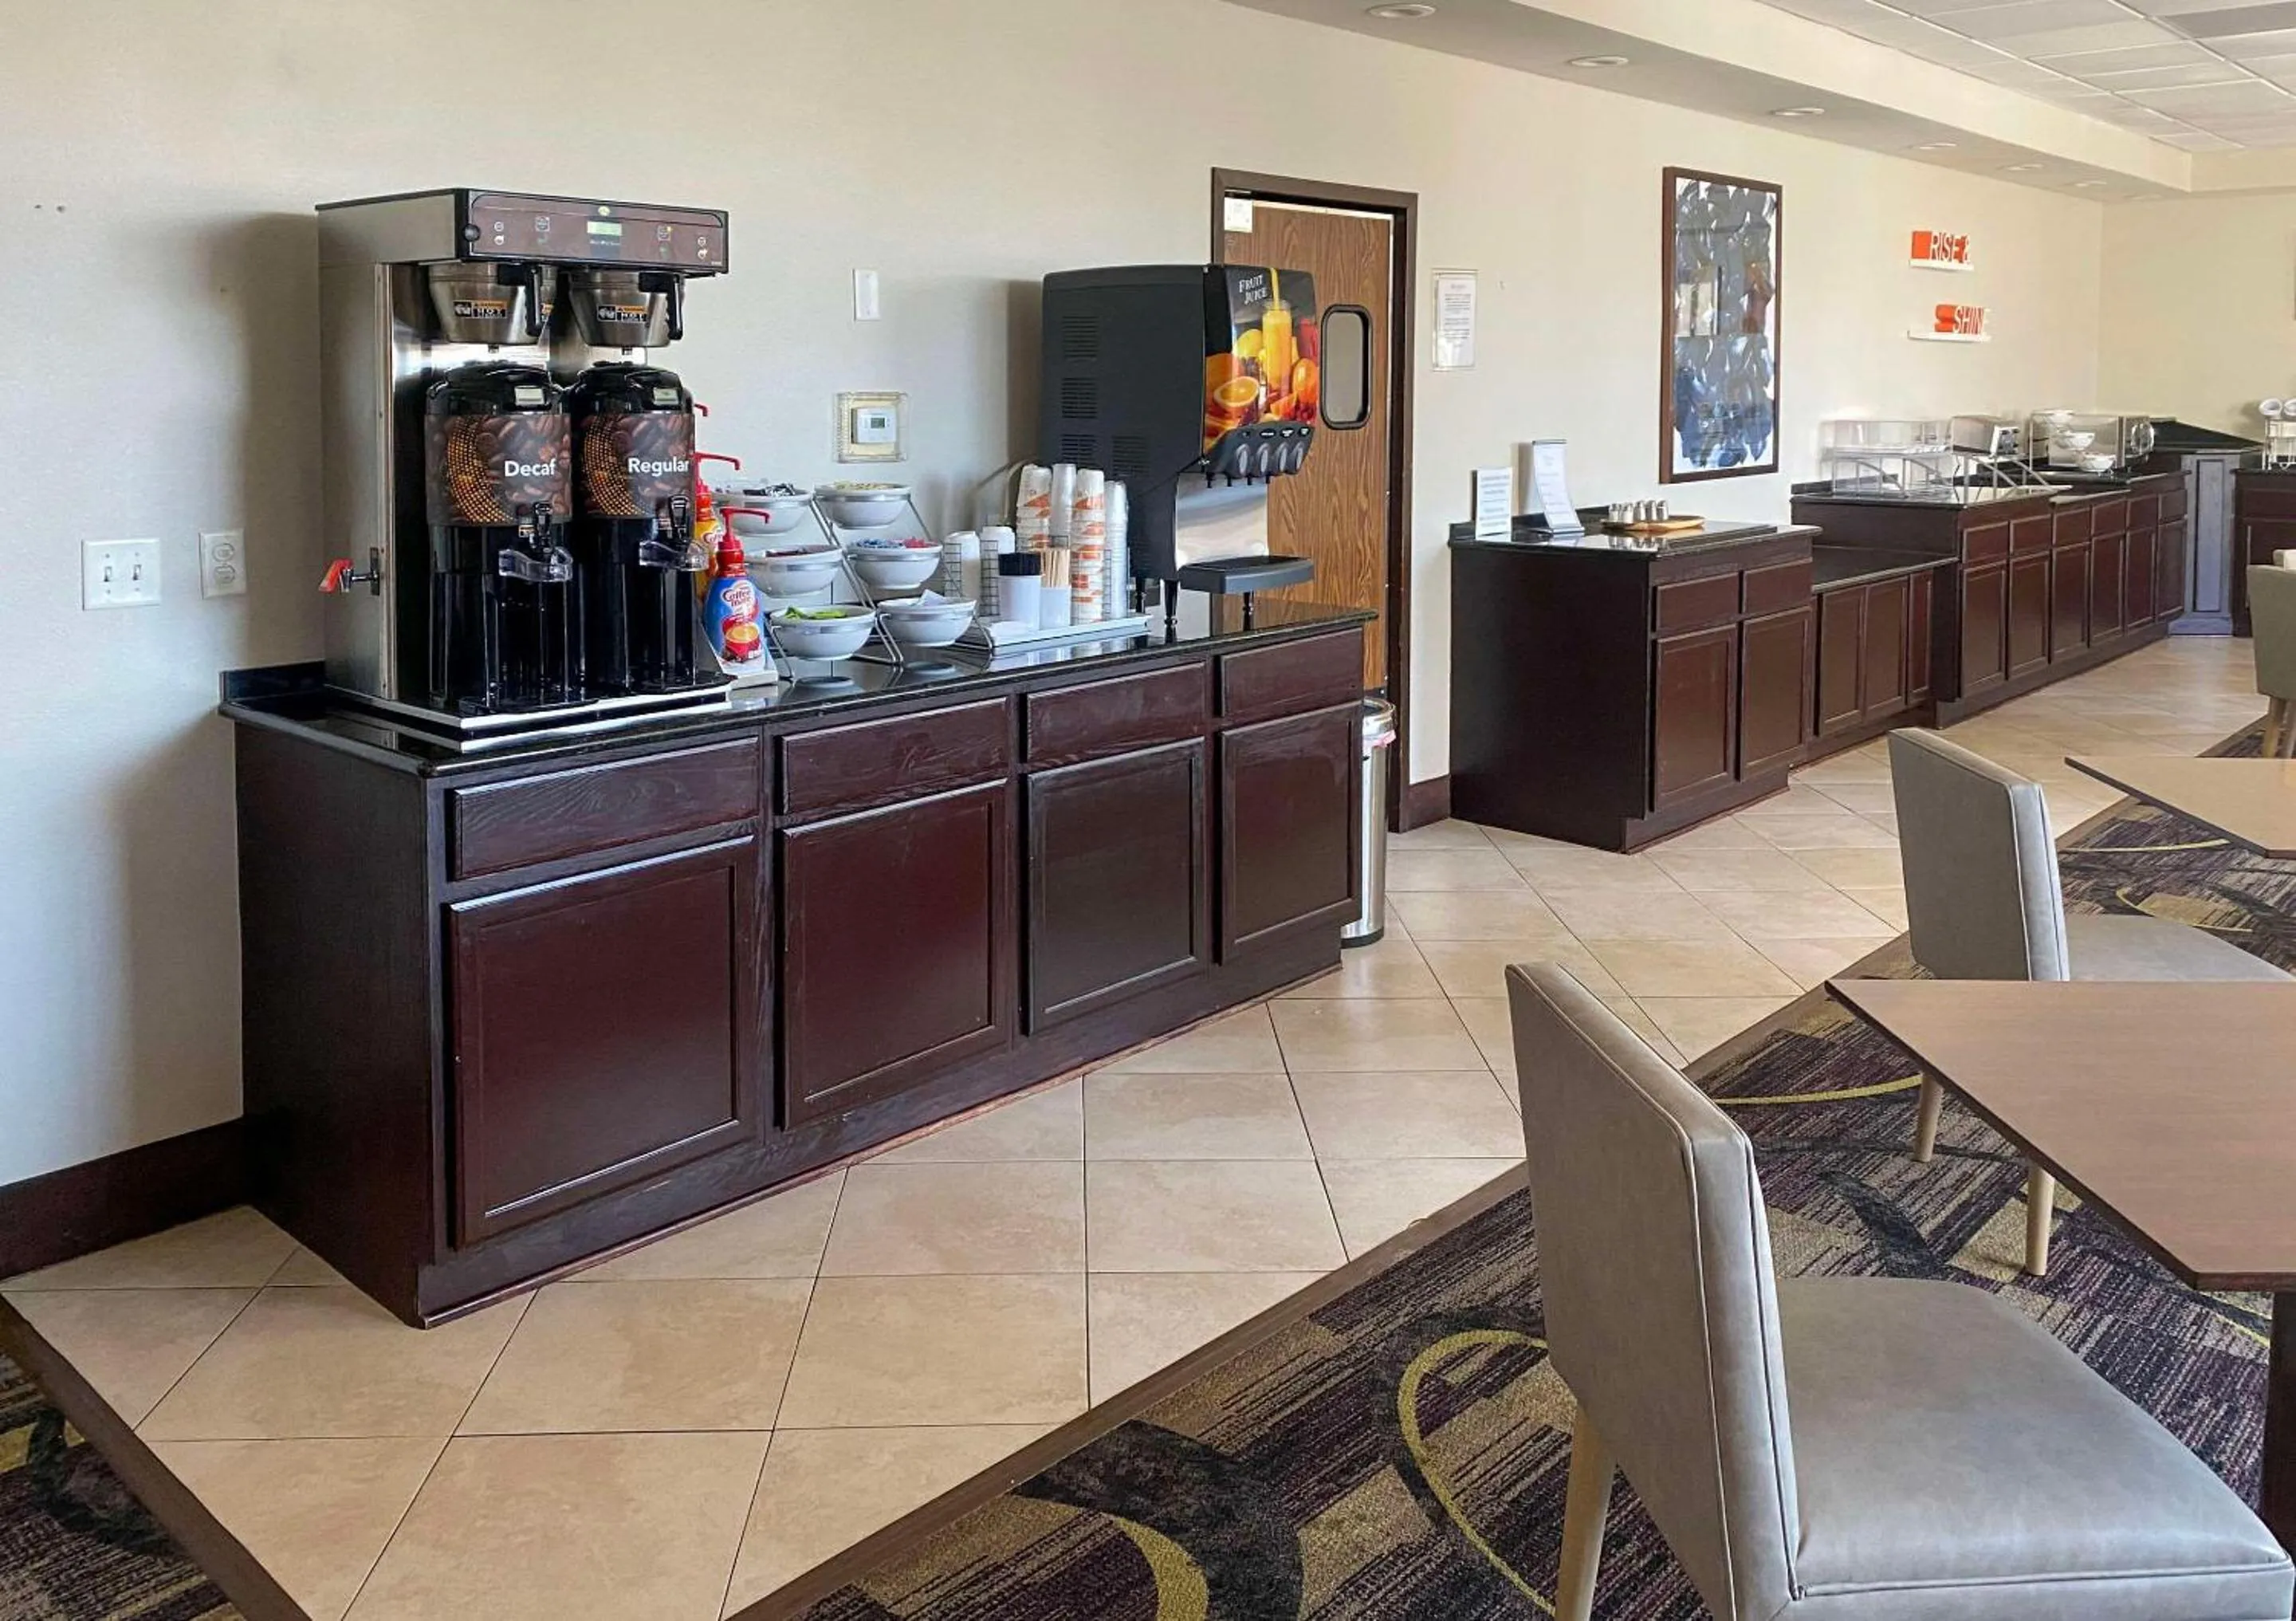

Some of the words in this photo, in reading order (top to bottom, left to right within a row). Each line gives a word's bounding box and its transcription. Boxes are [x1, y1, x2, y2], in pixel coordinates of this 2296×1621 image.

[1929, 231, 1960, 262] RISE
[1239, 274, 1264, 293] FRUIT
[1244, 287, 1268, 305] JUICE
[504, 458, 556, 478] Decaf
[628, 457, 690, 477] Regular
